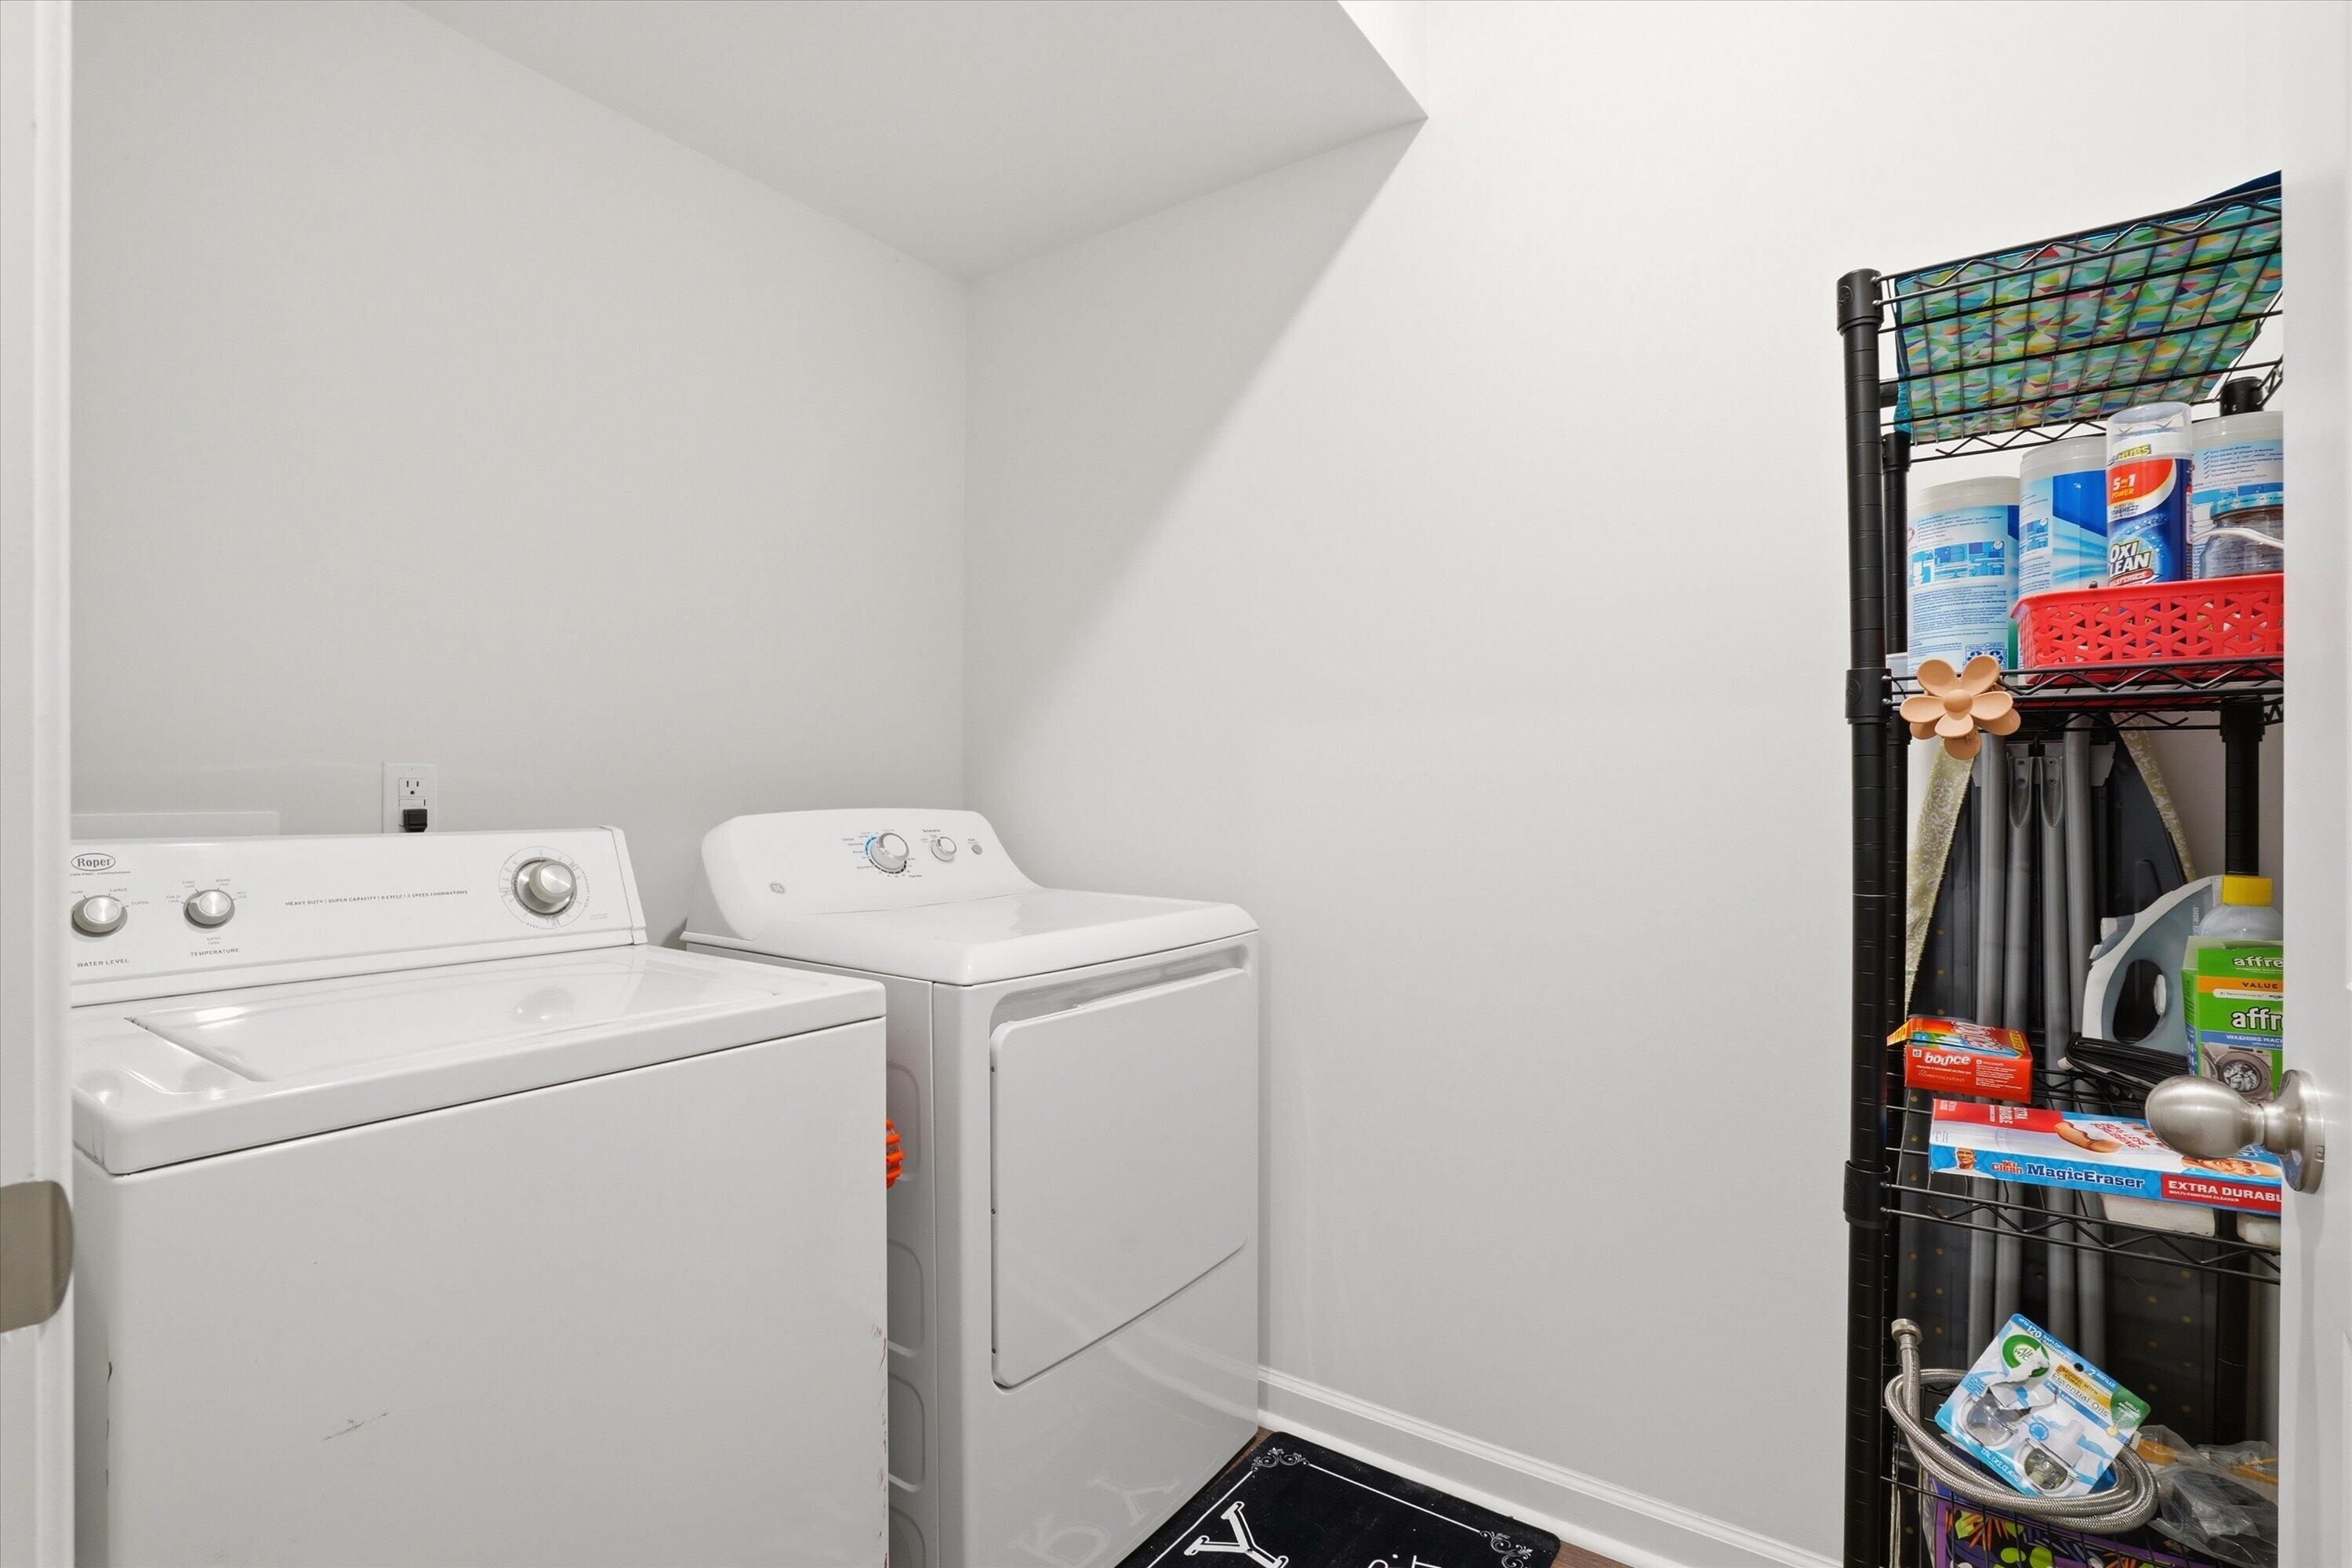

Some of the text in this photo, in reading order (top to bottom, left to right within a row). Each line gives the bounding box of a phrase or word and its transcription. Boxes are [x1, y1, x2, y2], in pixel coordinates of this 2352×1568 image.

[2111, 541, 2139, 562] OXI
[2109, 552, 2151, 577] LEAN
[77, 858, 111, 868] Roper
[191, 947, 239, 957] TEMPERATURE
[2230, 1007, 2283, 1032] affr
[1925, 1052, 1970, 1066] bounce
[2169, 1181, 2219, 1195] EXTRA
[2050, 1372, 2091, 1404] Essential
[2090, 1401, 2110, 1418] Oils
